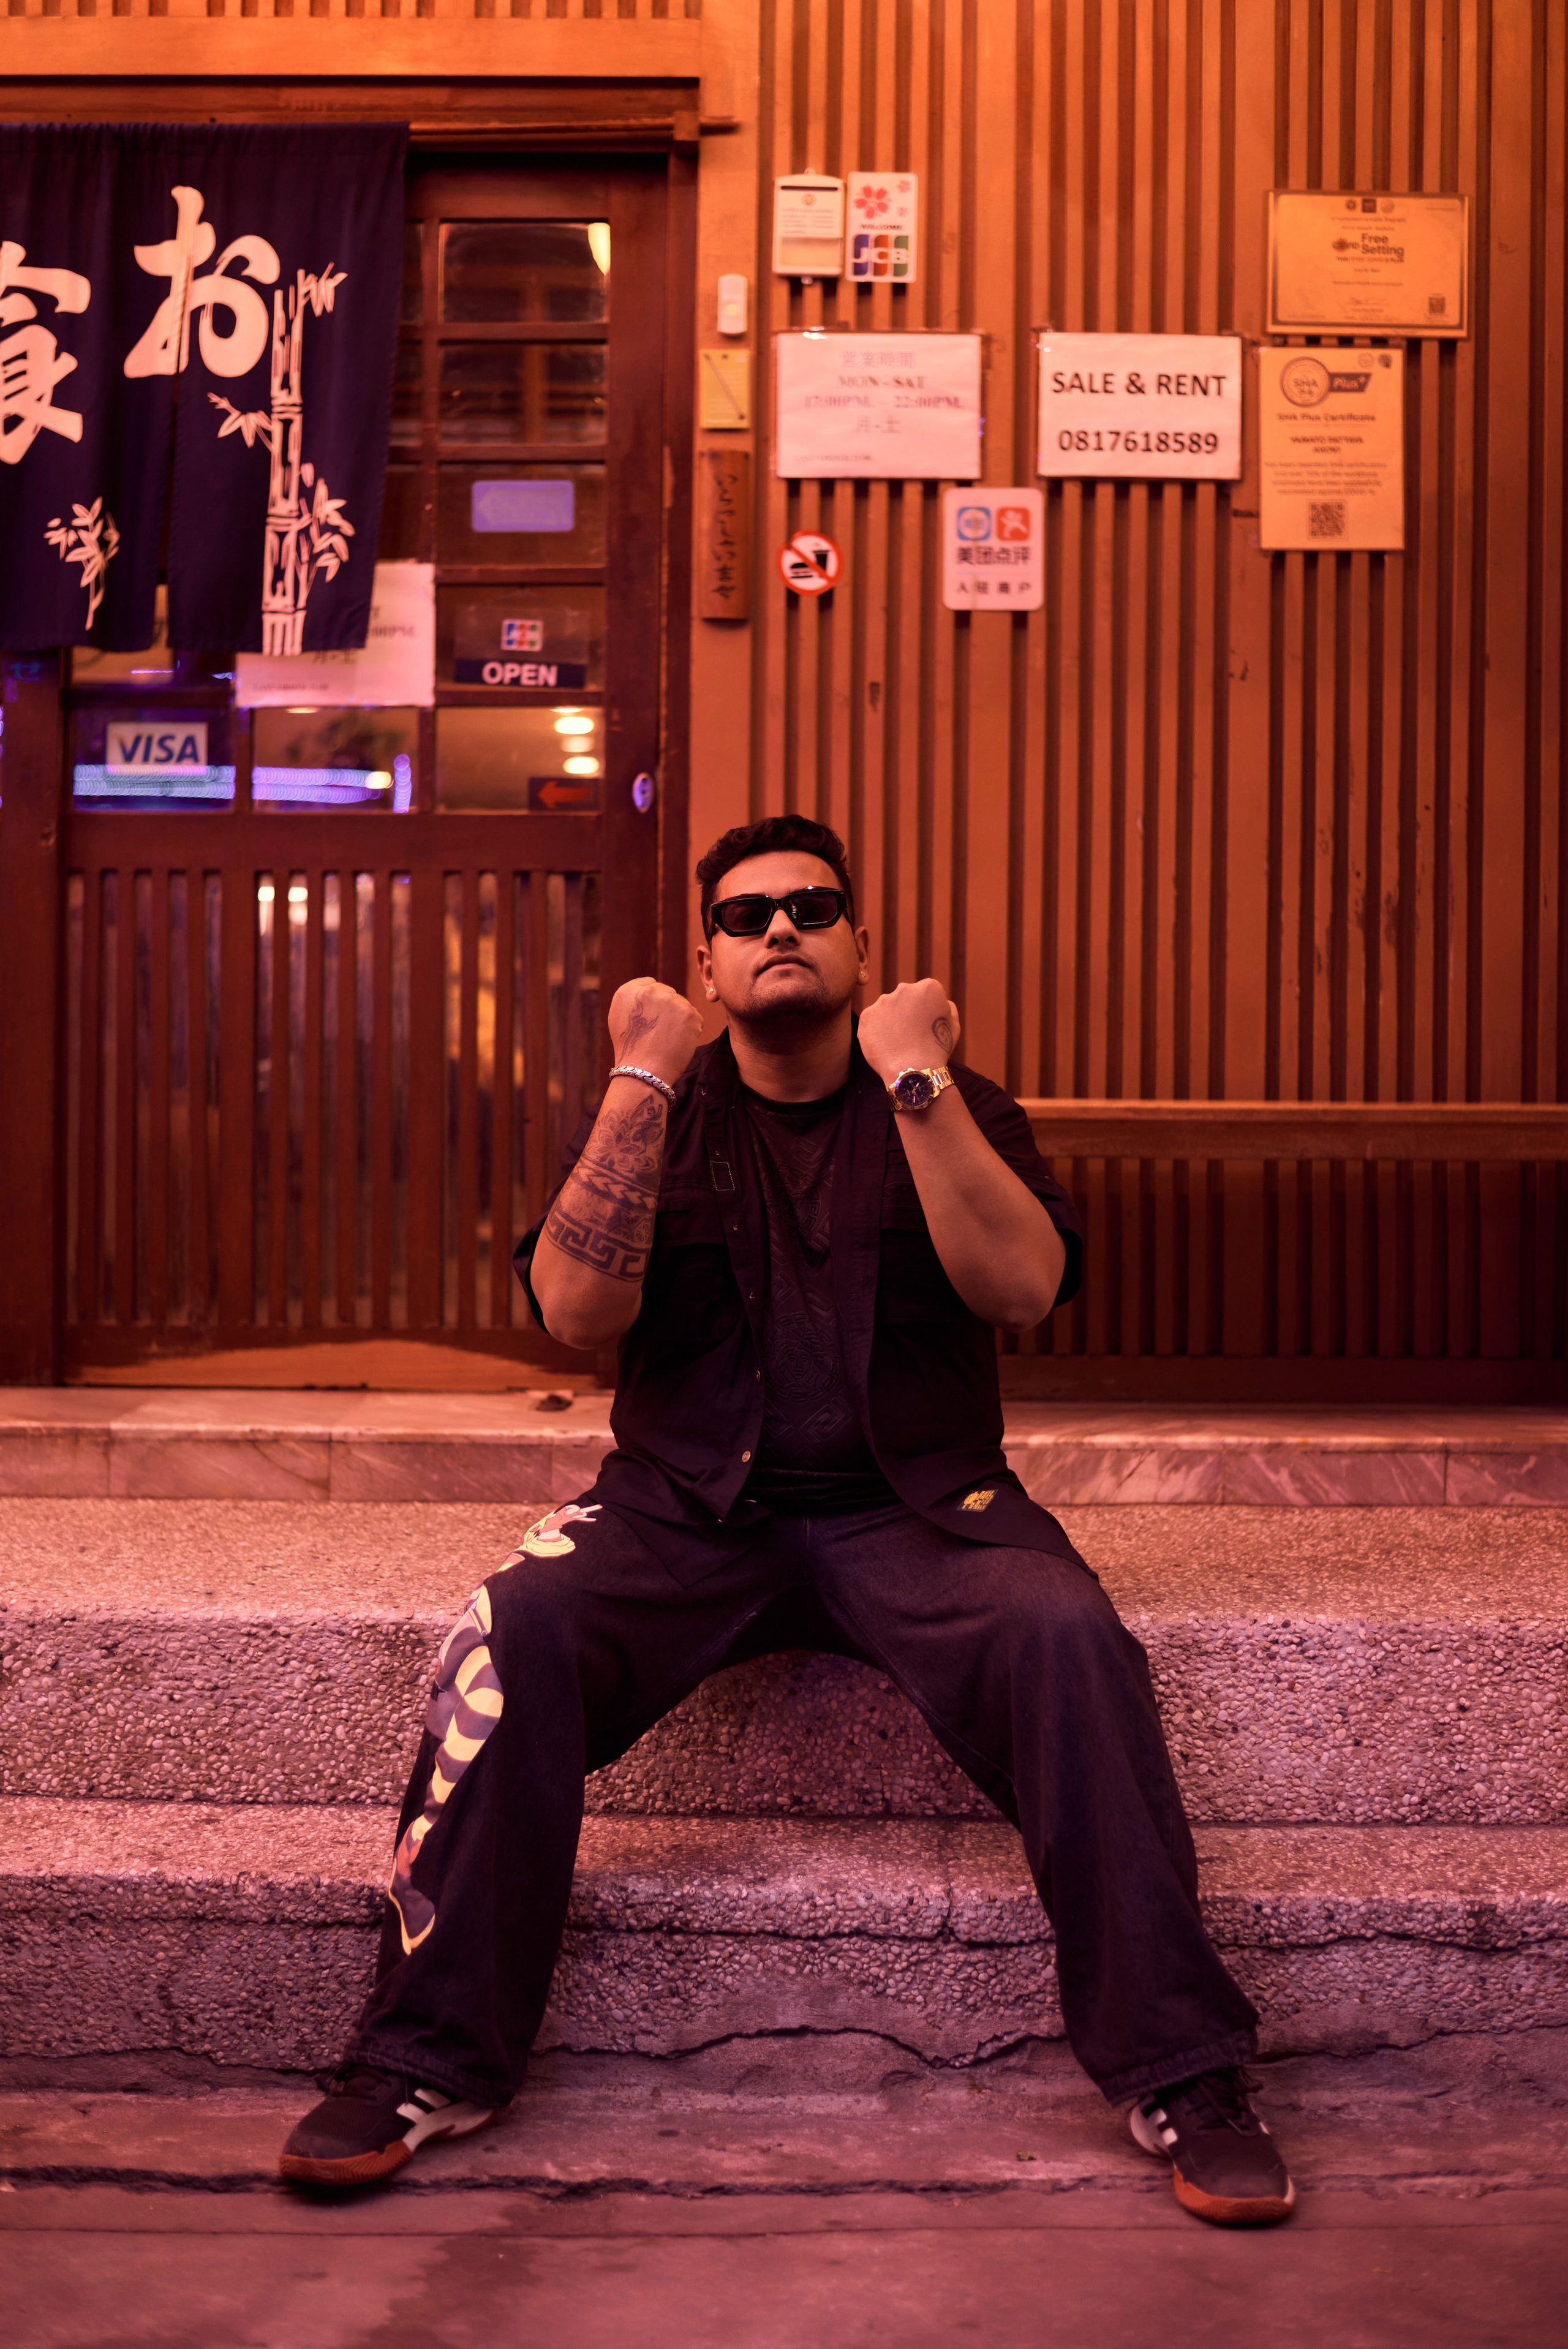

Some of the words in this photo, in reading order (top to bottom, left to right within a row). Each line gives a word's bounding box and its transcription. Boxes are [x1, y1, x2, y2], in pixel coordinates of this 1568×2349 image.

[1361, 233, 1389, 244] Free
[1361, 244, 1404, 257] Setting
[840, 350, 917, 369] 営業時間
[1052, 372, 1115, 394] SALE
[1126, 372, 1145, 394] &
[1158, 374, 1226, 396] RENT
[1058, 430, 1218, 454] 0817618589
[481, 661, 558, 687] OPEN
[118, 734, 200, 763] VISA
